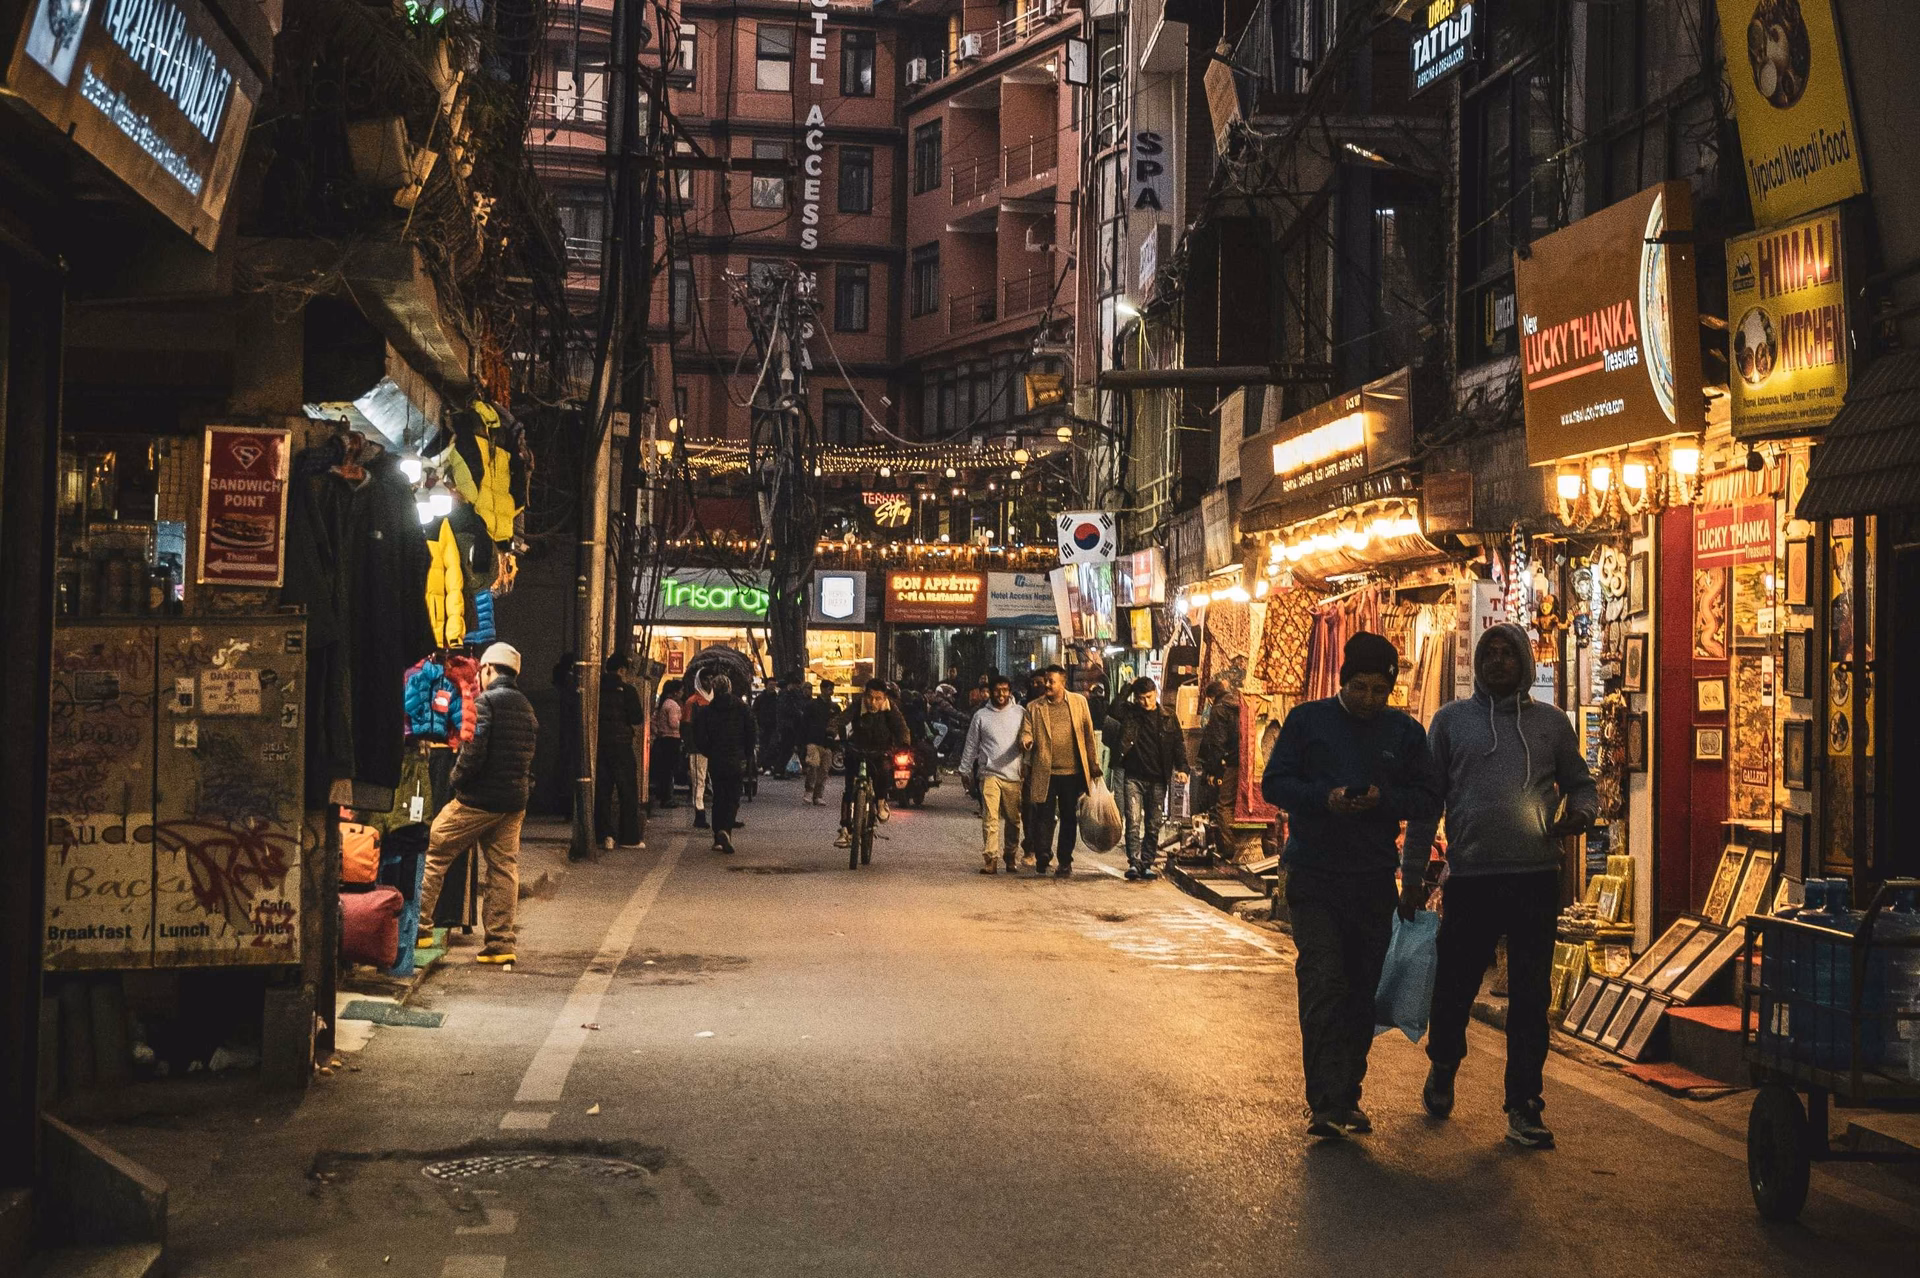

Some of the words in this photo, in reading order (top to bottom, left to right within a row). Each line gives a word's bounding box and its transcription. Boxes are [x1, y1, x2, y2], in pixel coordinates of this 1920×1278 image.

[1134, 132, 1164, 211] SPA
[1748, 146, 1787, 203] Typical
[1783, 132, 1822, 186] Nepali
[1819, 120, 1850, 168] Food
[801, 104, 826, 250] ACCESS
[1757, 219, 1841, 300] HIMALI
[1523, 313, 1538, 336] New
[1525, 322, 1570, 375] LUCKY
[1570, 299, 1638, 360] THANKA
[1781, 303, 1846, 372] KITCHEN
[1602, 345, 1639, 373] Treasures
[210, 478, 281, 493] SANDWICH
[224, 494, 266, 508] POINT
[1697, 525, 1728, 552] LUCKY
[1729, 518, 1771, 547] THANKA
[1744, 544, 1772, 559] Treasures
[893, 576, 921, 591] BON
[924, 574, 980, 592] APPÉTIT
[926, 592, 975, 603] RESTAURANT
[990, 590, 1008, 600] Hotel
[1009, 590, 1033, 601] Access
[210, 671, 252, 680] DANGER
[1743, 769, 1768, 785] GALLERY
[48, 922, 132, 941] Breakfast
[159, 922, 210, 938] Lunch
